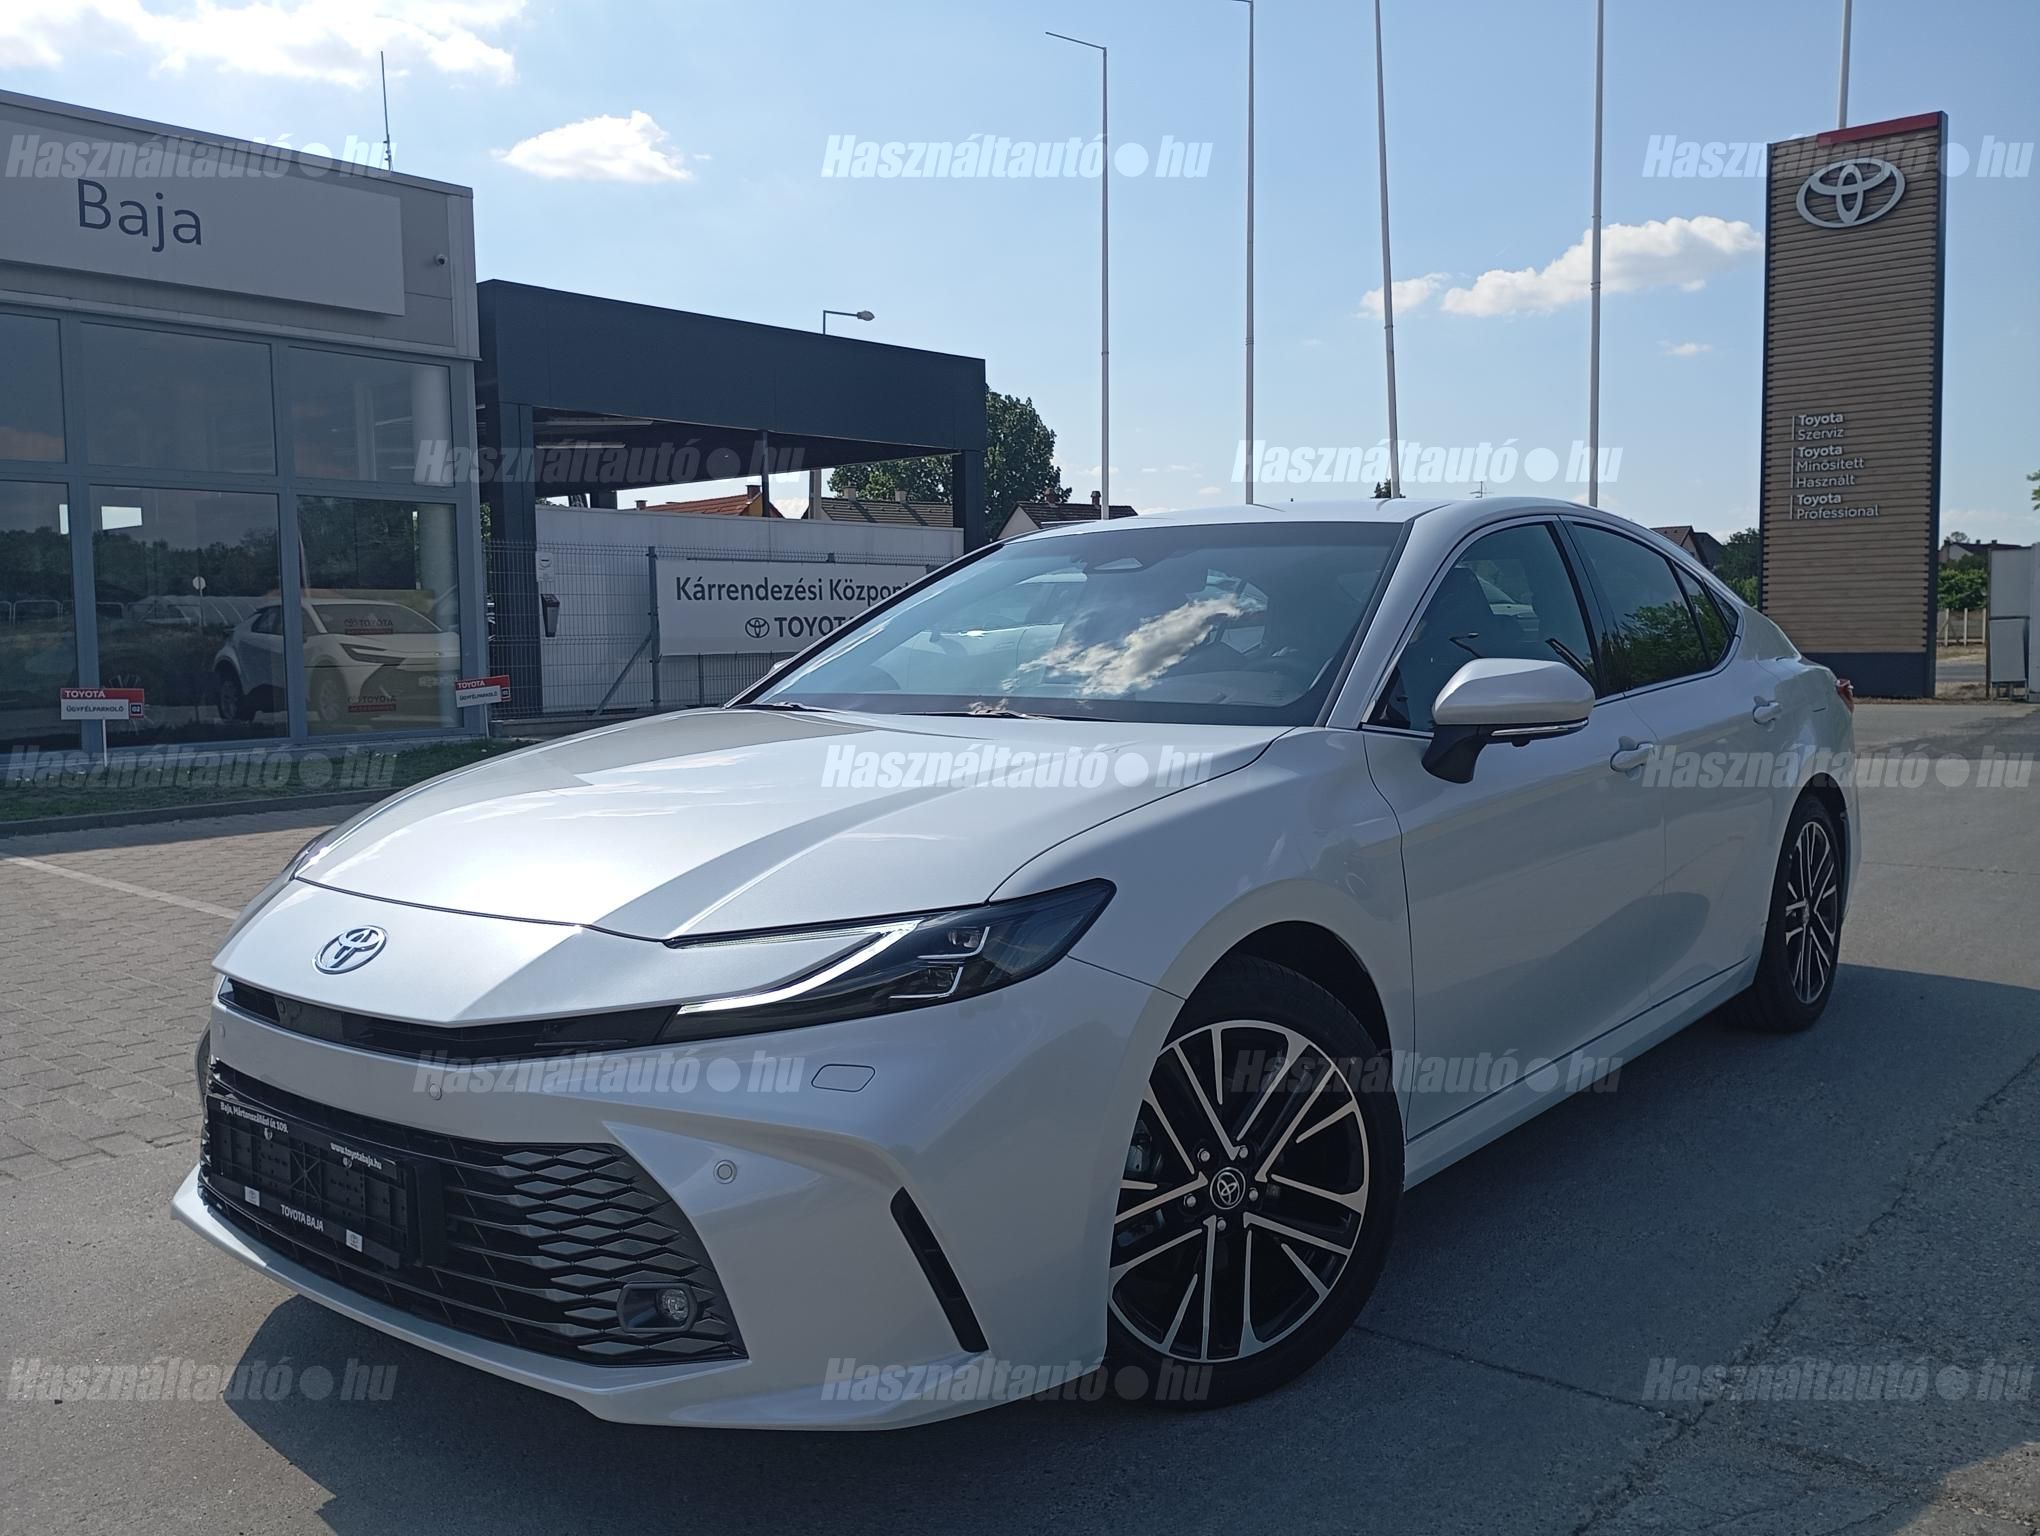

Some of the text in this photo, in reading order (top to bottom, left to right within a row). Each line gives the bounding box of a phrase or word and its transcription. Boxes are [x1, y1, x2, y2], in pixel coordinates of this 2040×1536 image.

[77, 178, 202, 252] Baja
[1798, 413, 1844, 427] Toyota
[1798, 427, 1844, 440] Szerviz
[1797, 445, 1843, 459] Toyota
[1796, 474, 1856, 488] Használt
[1796, 492, 1842, 507] Toyota
[1796, 504, 1879, 519] Professional
[675, 576, 909, 607] Kárrendezési Közpon
[774, 615, 854, 637] TOYOT
[457, 680, 486, 689] TOYOTA
[65, 690, 106, 698] TOYOTA
[66, 705, 125, 713] ÜGYFÉLPARKOLÓ
[280, 1204, 324, 1232] TOYOTA BAJA
